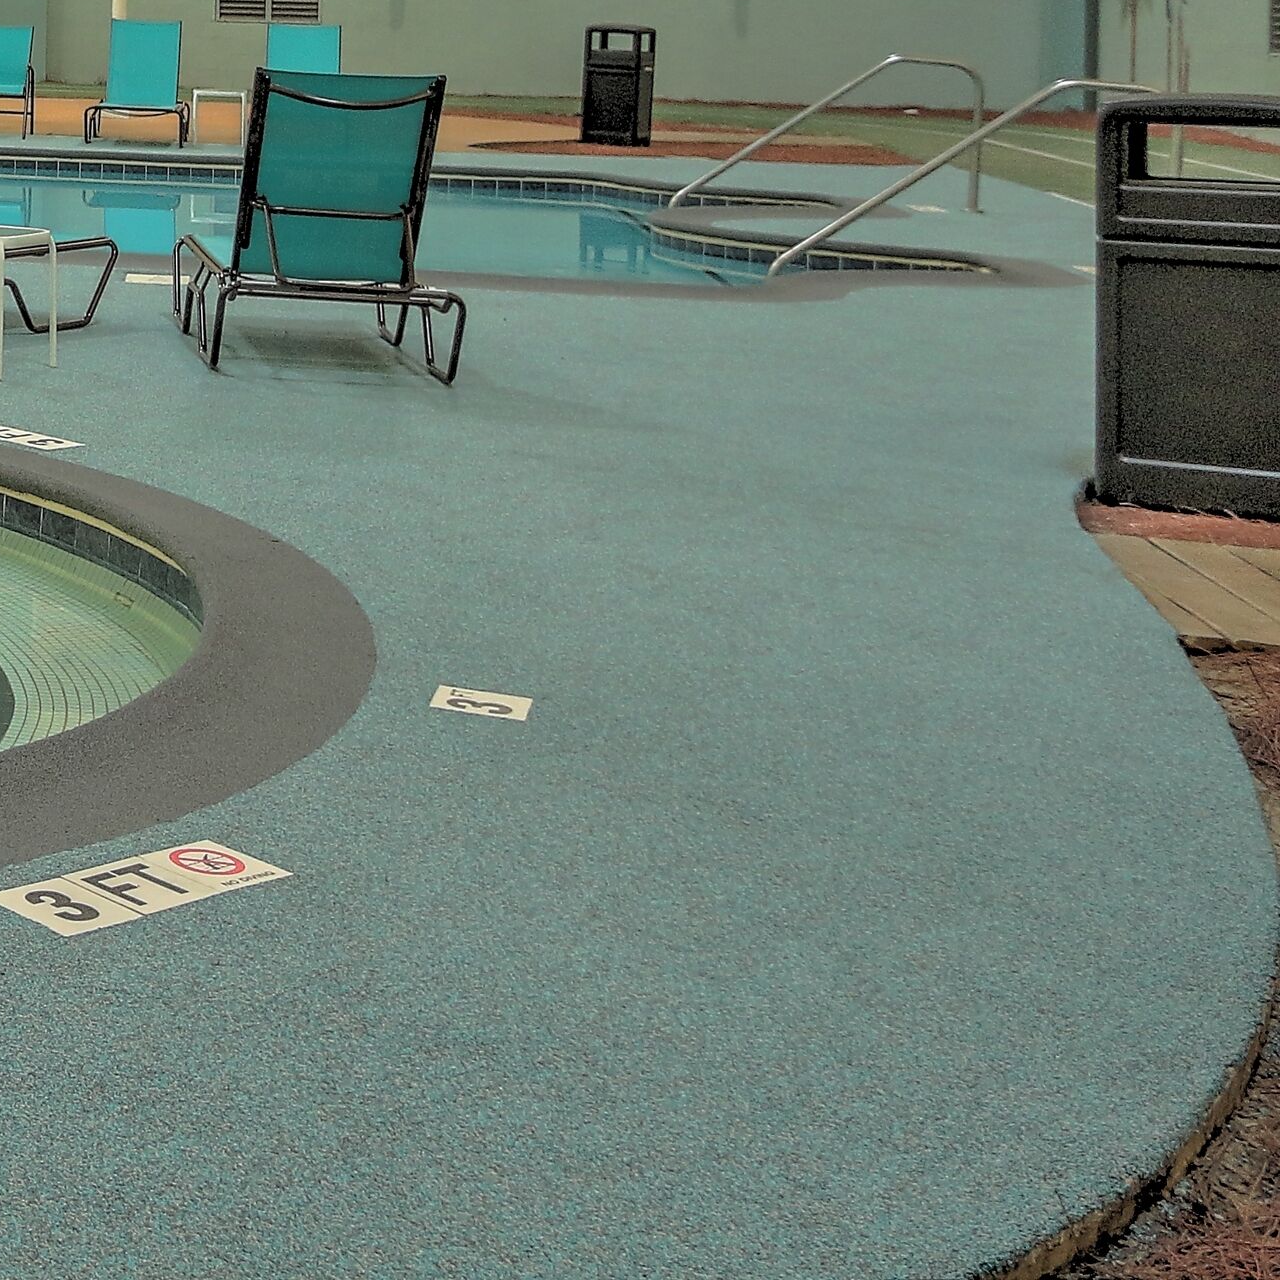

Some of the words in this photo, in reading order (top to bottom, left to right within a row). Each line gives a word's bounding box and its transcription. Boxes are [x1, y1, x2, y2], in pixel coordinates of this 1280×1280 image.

[446, 697, 513, 715] 3
[23, 887, 101, 923] 3
[80, 862, 190, 907] FT
